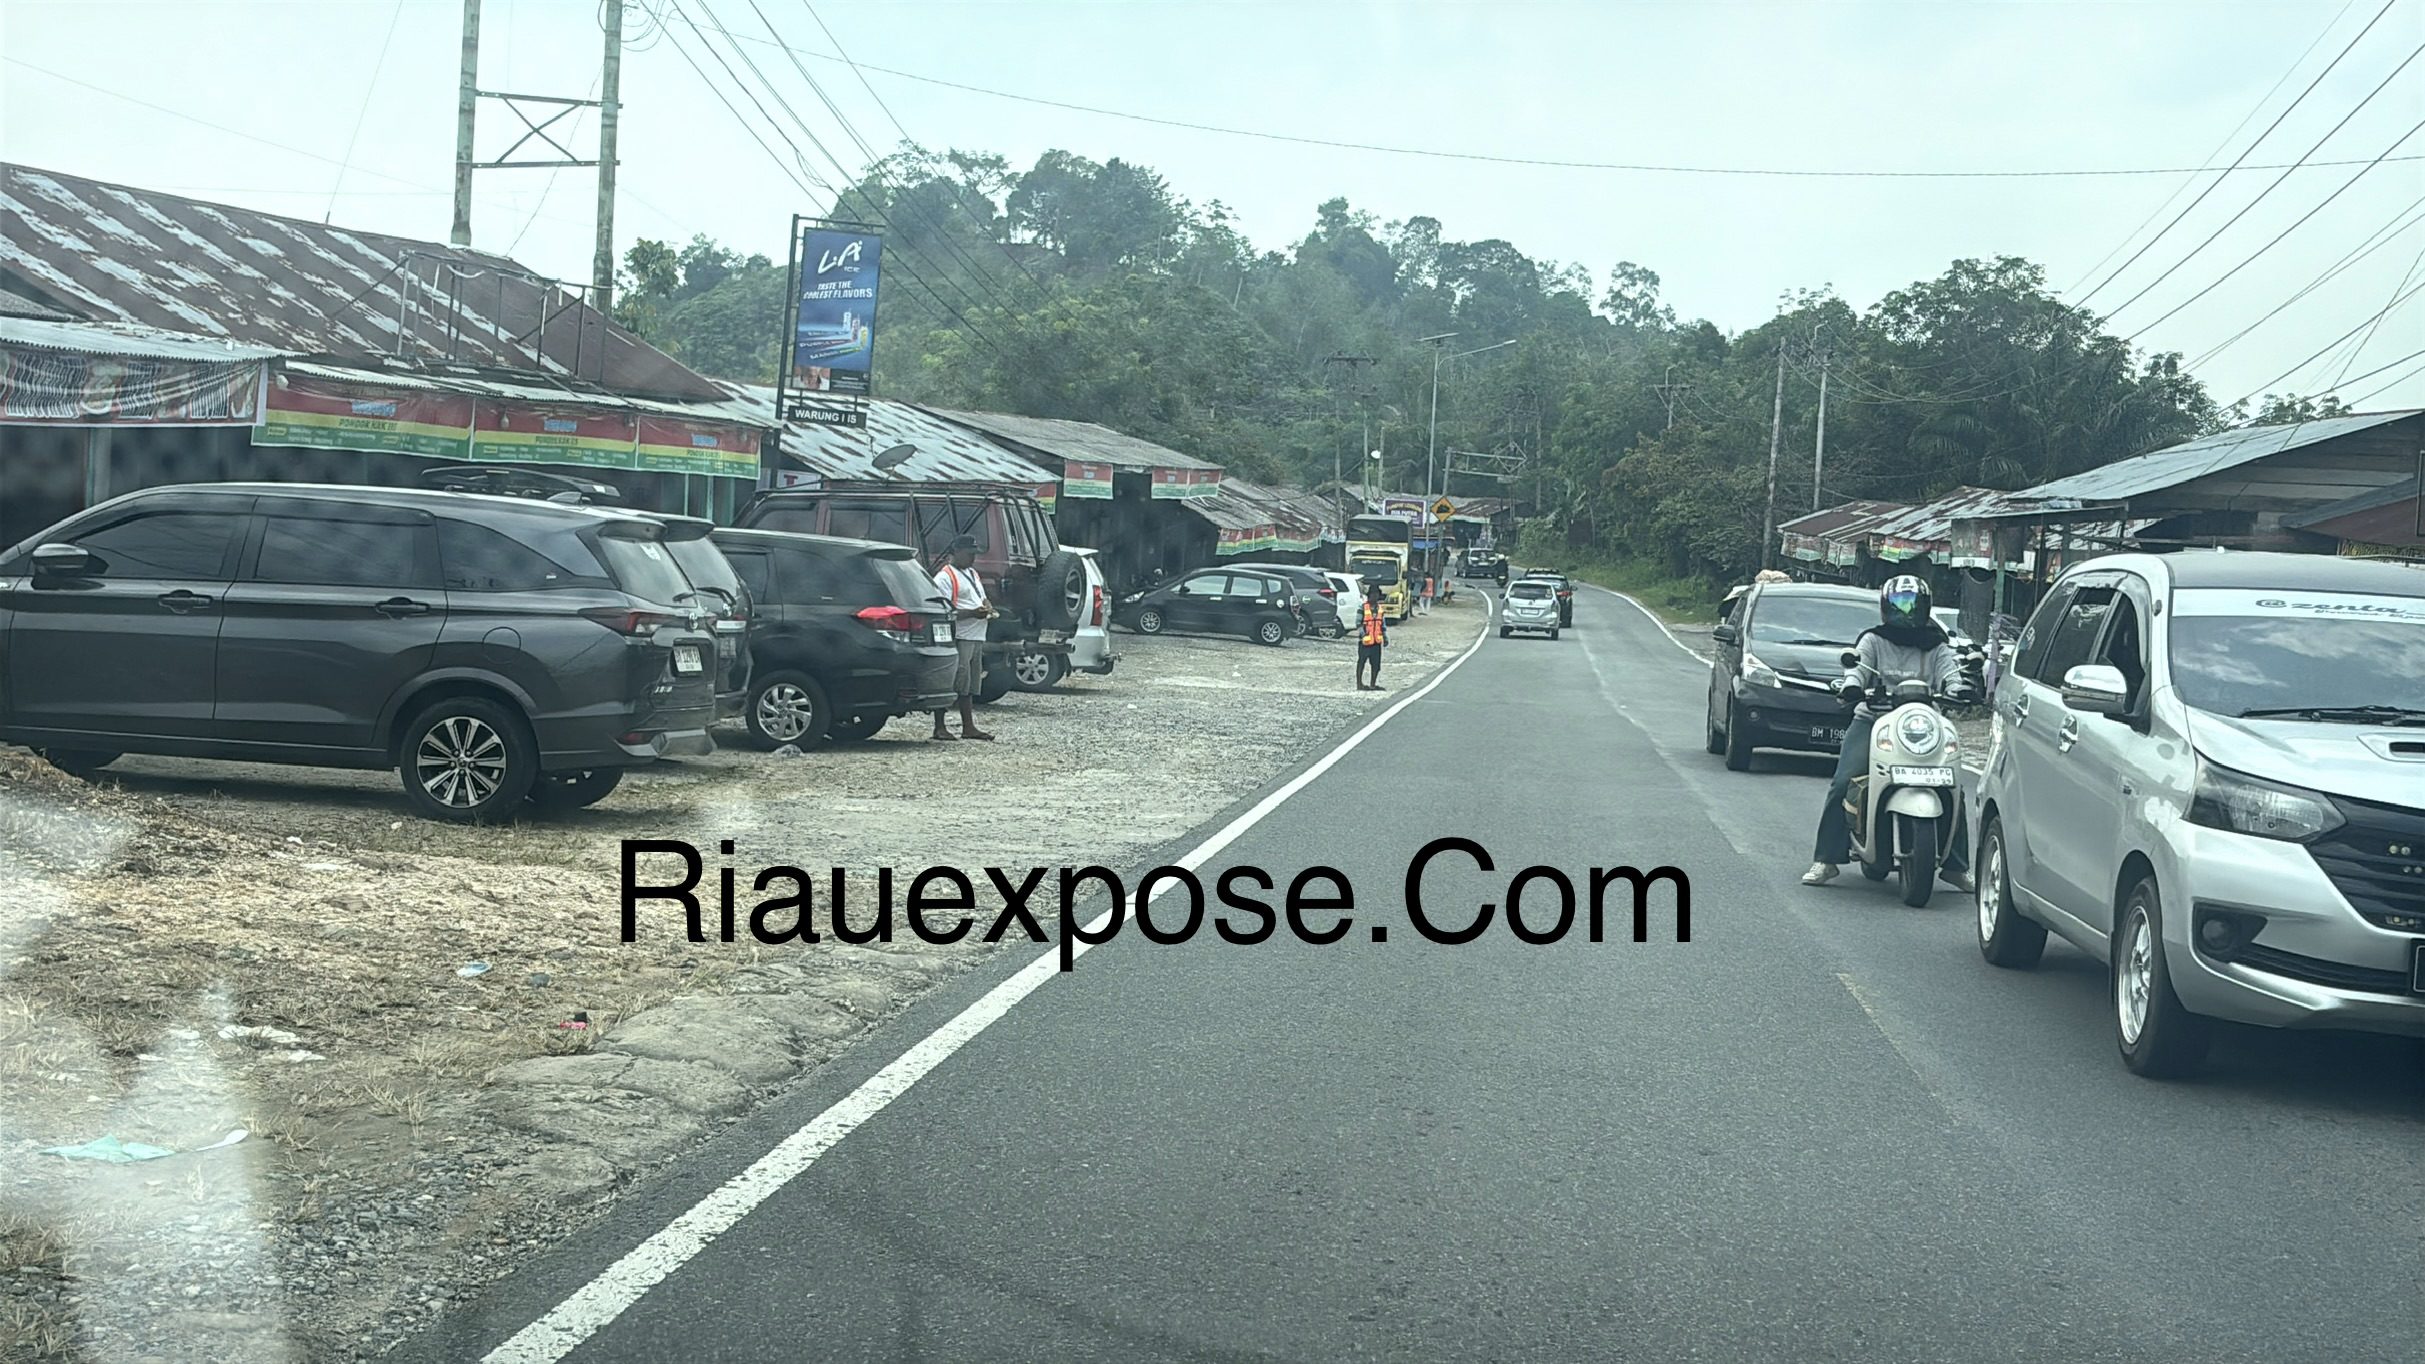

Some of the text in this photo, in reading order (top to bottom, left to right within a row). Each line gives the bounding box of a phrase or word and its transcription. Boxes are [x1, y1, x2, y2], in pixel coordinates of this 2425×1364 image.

[817, 280, 853, 291] TASTE THE
[803, 287, 873, 300] COOLEST FLAVORS
[795, 409, 840, 421] WARUNG
[1811, 727, 1846, 739] BM 198
[1894, 767, 1907, 775] BA
[1911, 768, 1934, 776] 4035
